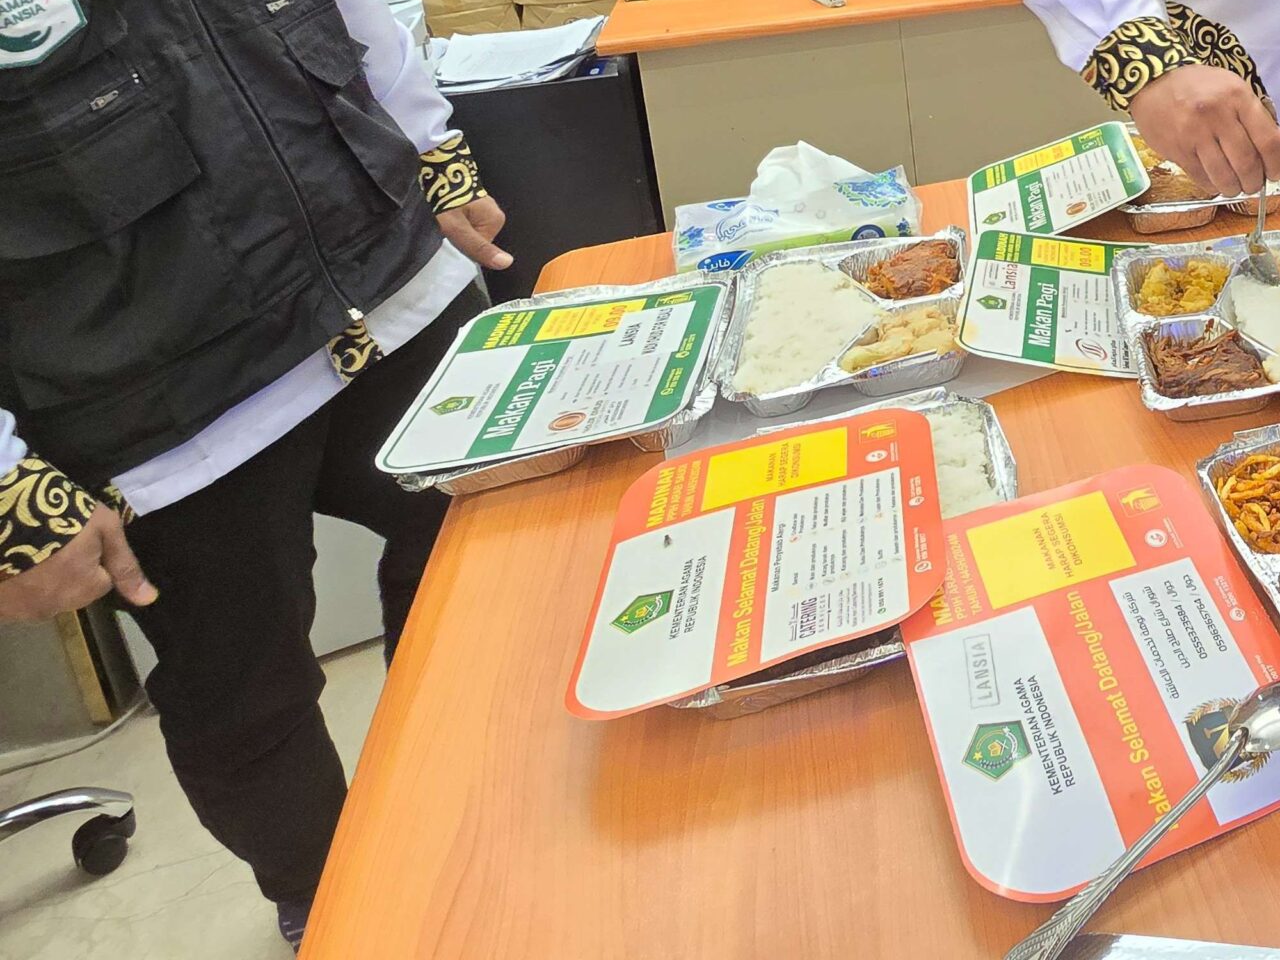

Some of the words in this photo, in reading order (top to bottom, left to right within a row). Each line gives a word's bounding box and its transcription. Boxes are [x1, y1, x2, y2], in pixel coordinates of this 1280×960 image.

[1024, 181, 1043, 203] Pagi
[1000, 263, 1019, 290] Lansia
[1036, 283, 1058, 309] Pagi
[1027, 309, 1054, 348] Makan
[482, 391, 537, 440] Makan
[516, 358, 557, 393] Pagi
[645, 466, 675, 527] MADINAH
[739, 498, 764, 568] Datang/Jalan
[1031, 527, 1056, 569] MAKANAN
[1039, 511, 1060, 546] SEGERA
[1053, 512, 1083, 565] DIKONSUMSI
[771, 565, 780, 592] Makanan
[1054, 547, 1074, 577] HARAP
[669, 584, 688, 639] KEMENTERIAN
[680, 558, 693, 584] AGAMA
[684, 594, 699, 633] REPUBLIK
[692, 555, 706, 594] INDONESIA
[732, 566, 757, 618] Selamat
[799, 596, 816, 639] CATERING
[950, 595, 968, 619] PPIH
[963, 584, 983, 615] TAHUN
[1162, 579, 1179, 598] جوال
[1174, 604, 1208, 659] 0555323584
[1181, 573, 1196, 591] جوال
[1193, 597, 1227, 652] 0596365764
[728, 618, 751, 666] Makan
[1063, 590, 1120, 691] Datang/Jalan
[1122, 590, 1140, 614] شركة
[1142, 636, 1165, 668] لخدمات
[1154, 607, 1171, 627] شارع
[1173, 647, 1191, 669] الدين
[971, 639, 993, 702] LANSIA
[1013, 676, 1035, 716] AGAMA
[1026, 674, 1055, 730] INDONESIA
[1105, 691, 1151, 764] Selamat
[1026, 714, 1062, 796] KEMENTERIAN
[1045, 730, 1075, 788] REPUBLIK
[1138, 765, 1179, 832] akan
